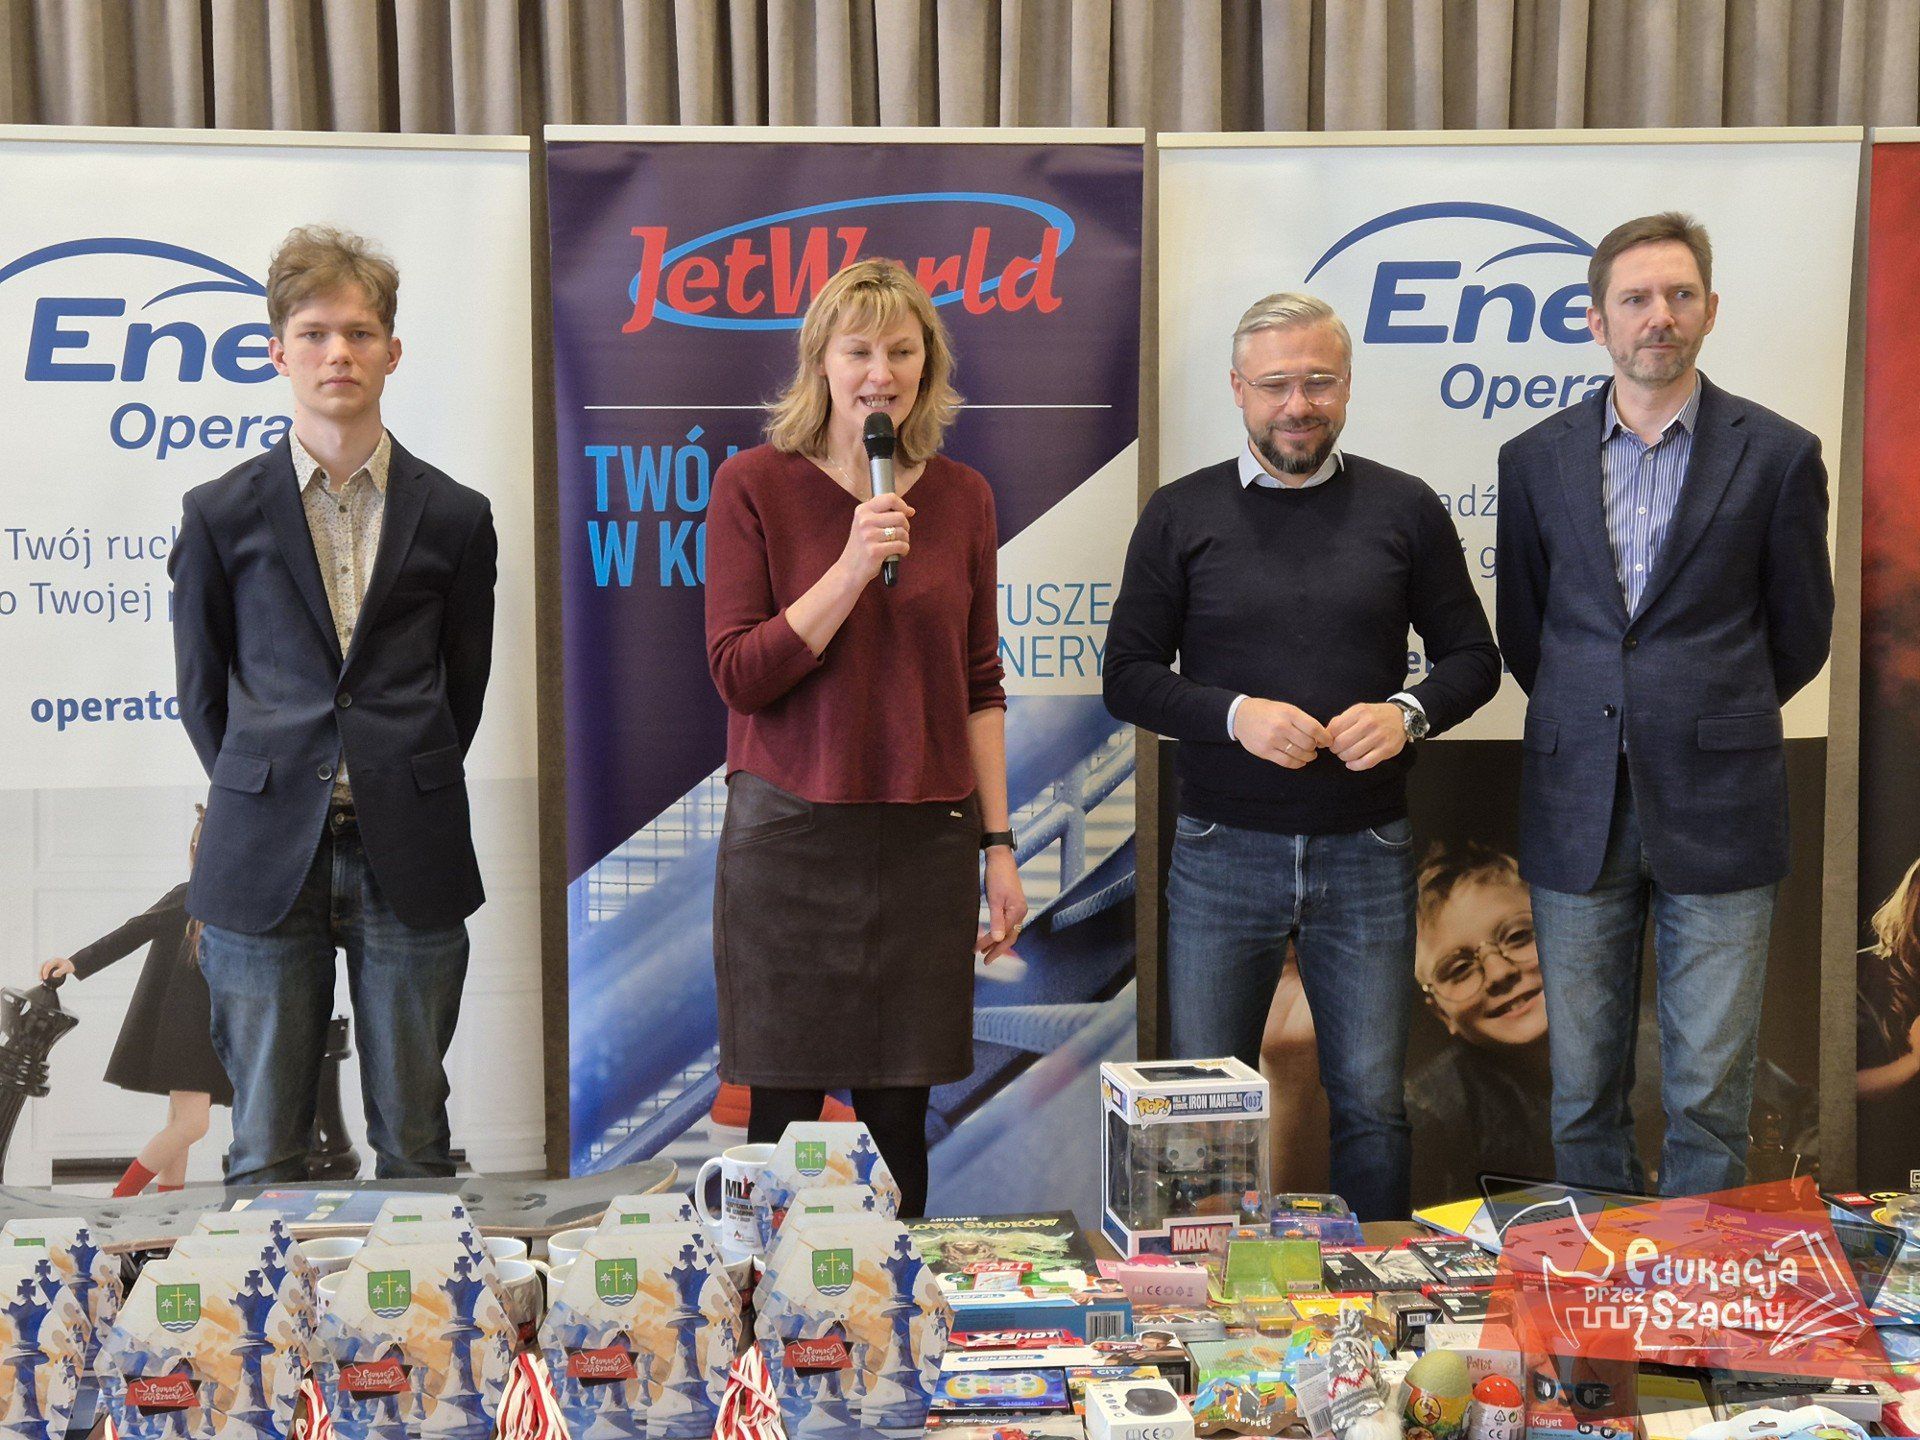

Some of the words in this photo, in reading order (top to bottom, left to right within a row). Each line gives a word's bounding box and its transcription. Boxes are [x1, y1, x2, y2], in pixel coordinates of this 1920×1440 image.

[622, 226, 1062, 333] JetWrld
[585, 424, 738, 512] TWÓ
[5, 526, 91, 569] Twój
[587, 520, 638, 587] W
[659, 520, 707, 587] K
[29, 582, 151, 623] Twojej
[997, 583, 1112, 626] USZE
[998, 635, 1108, 678] NERY
[1188, 1096, 1208, 1110] IRON
[1209, 1094, 1227, 1109] MAN
[1244, 1095, 1261, 1108] 1037
[1532, 1416, 1563, 1428] Kayet
